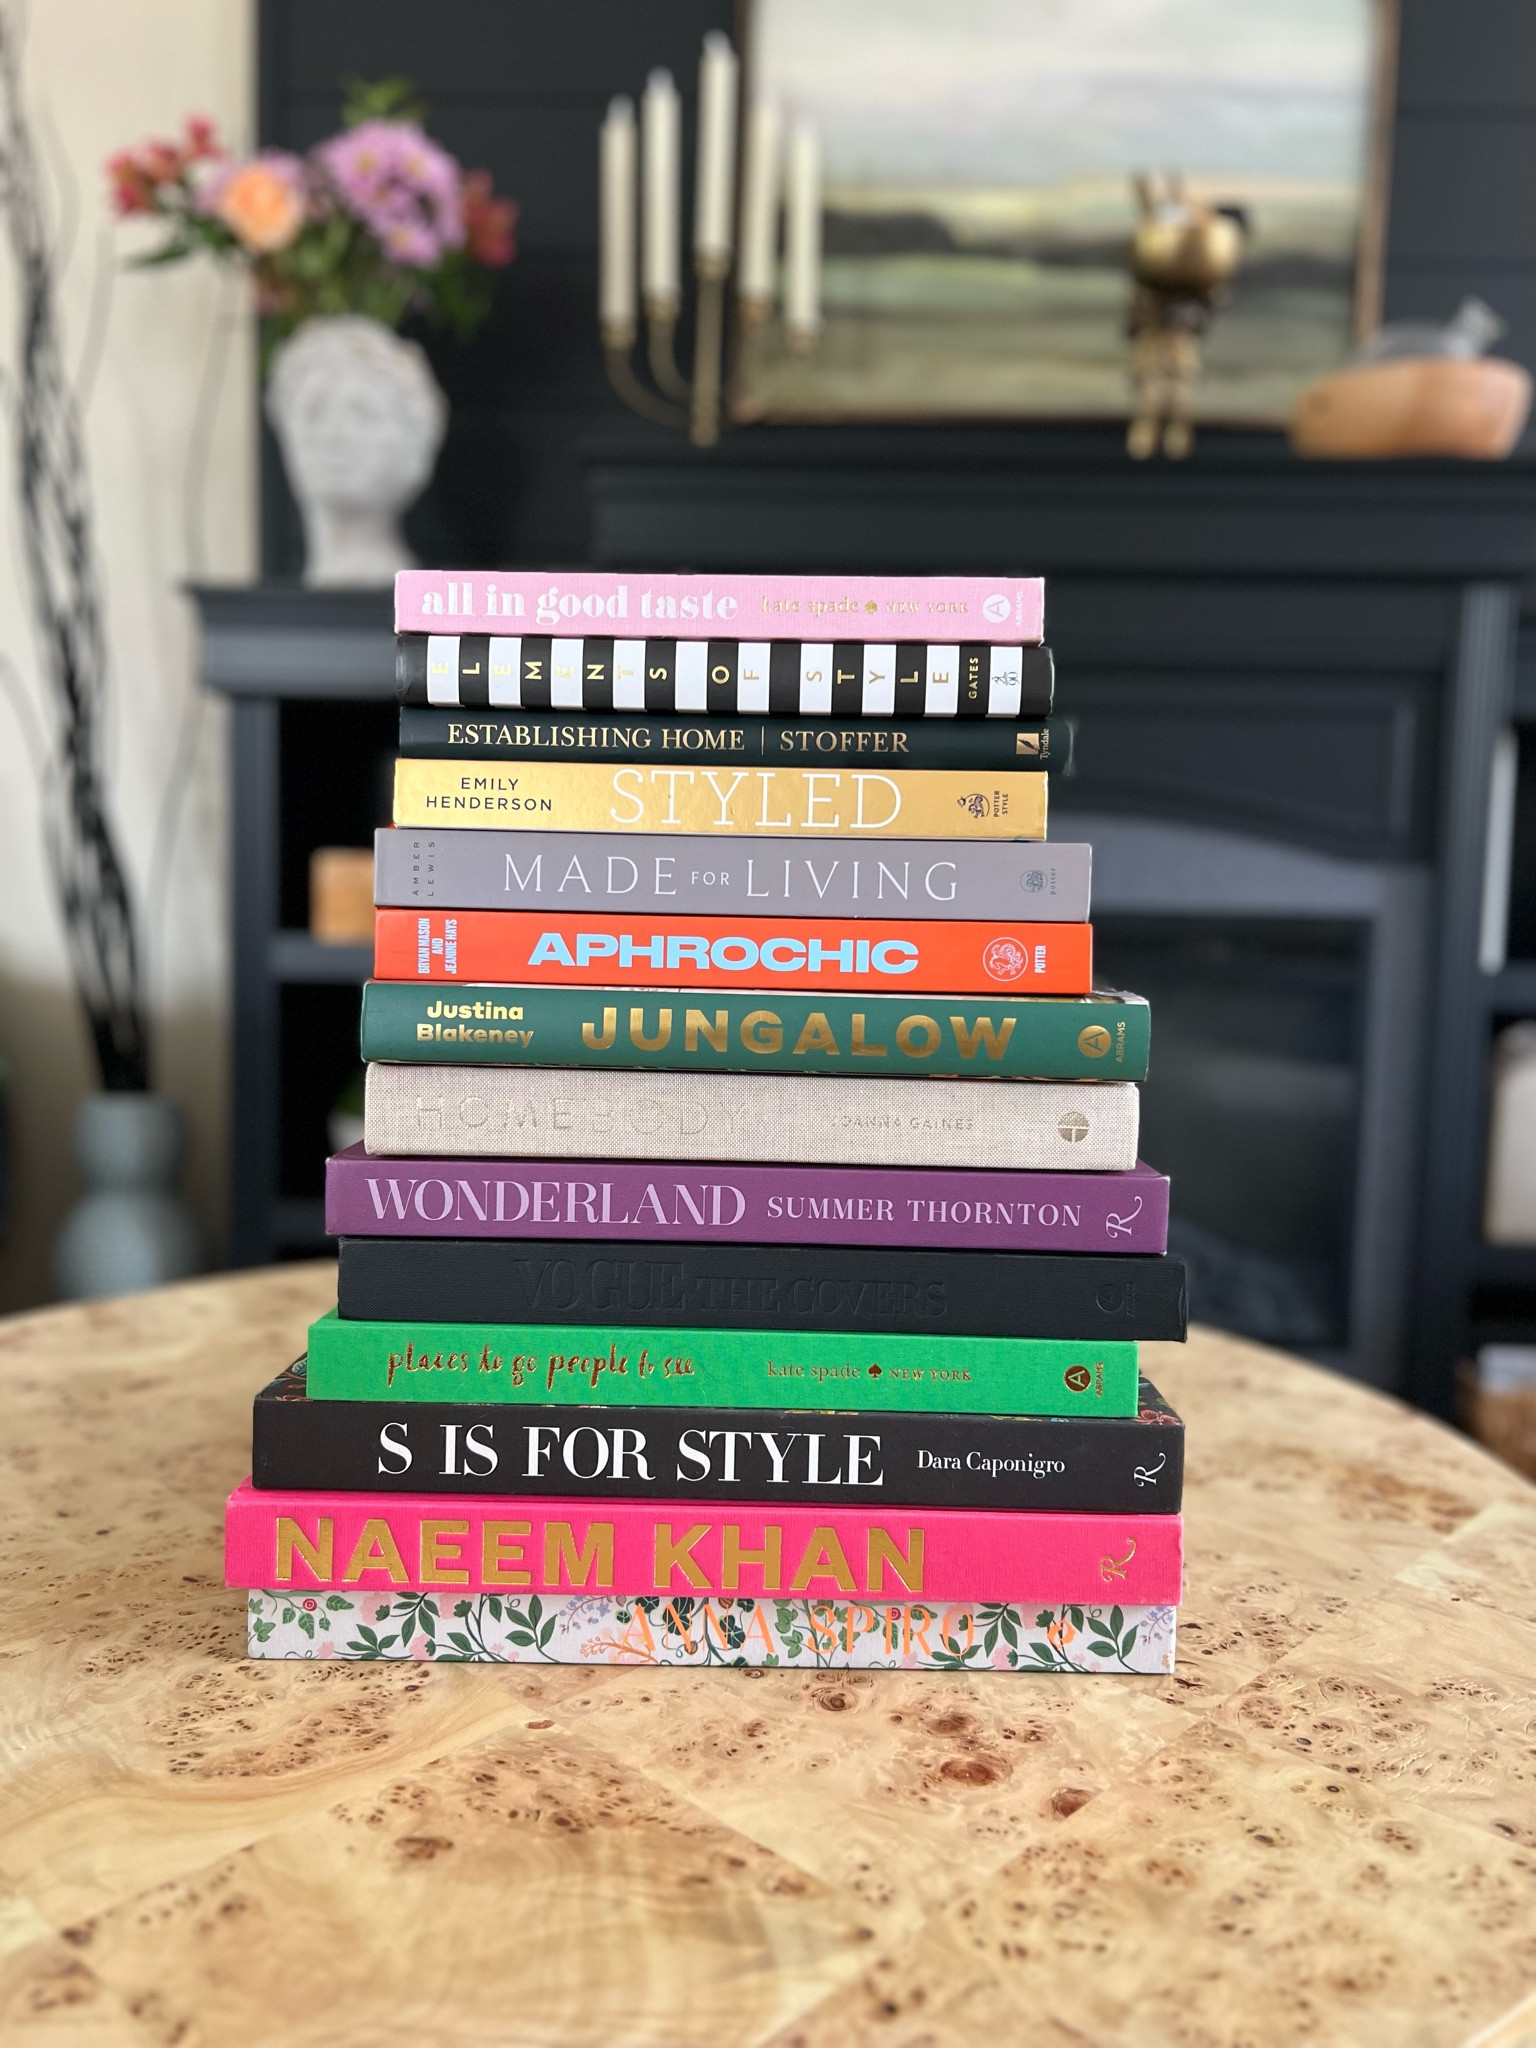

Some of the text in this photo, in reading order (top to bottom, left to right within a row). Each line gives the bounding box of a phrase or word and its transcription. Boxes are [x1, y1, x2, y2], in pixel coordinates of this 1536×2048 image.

[421, 581, 738, 625] all in good taste
[762, 596, 969, 617] kate spade NEW YORK
[1014, 590, 1024, 628] ABRAMS
[431, 660, 949, 685] ELEMENTS OF STYLE
[968, 657, 979, 699] GATES
[448, 723, 745, 751] ESTABLISHING HOME
[780, 730, 910, 753] STOFFER
[1040, 728, 1051, 760] Tyndale
[461, 777, 519, 791] EMILY
[609, 767, 902, 829] STYLED
[426, 796, 552, 811] HENDERSON
[1001, 793, 1009, 815] STYLE
[412, 841, 420, 896] AMBER
[427, 841, 435, 897] LEWIS
[503, 853, 958, 901] MADE FOR LIVING
[418, 917, 430, 974] BRYAN MASON
[431, 937, 443, 955] AND
[444, 919, 457, 940] HAYS
[527, 932, 919, 975] APHROCHIC
[1034, 945, 1046, 973] POTTER
[427, 1001, 524, 1021] Justina
[416, 1023, 534, 1048] Blakeney
[582, 1006, 1017, 1061] JUNGALOW
[1115, 1021, 1126, 1063] ABRAMS
[415, 1095, 746, 1135] HOMEBODY
[910, 1117, 974, 1131] GAINES
[364, 1177, 747, 1227] WONDERLAND
[767, 1196, 1082, 1228] SUMMER THORNTON
[1105, 1195, 1143, 1240] R
[512, 1257, 949, 1317] VOGUE THE COVERS
[387, 1341, 469, 1388] places
[478, 1343, 503, 1373] to
[511, 1354, 538, 1387] go
[547, 1343, 628, 1392] people
[663, 1356, 696, 1378] see
[767, 1361, 973, 1383] kate spade NEW YORK
[1094, 1361, 1104, 1398] ABRAMS
[378, 1421, 885, 1487] S IS FOR STYLE
[917, 1449, 1066, 1480] Dara Caponigro
[1133, 1451, 1166, 1488] R
[275, 1516, 926, 1593] NAEEM KHAN
[1100, 1536, 1137, 1584] R
[620, 1602, 976, 1657] ANNA SPIRO
